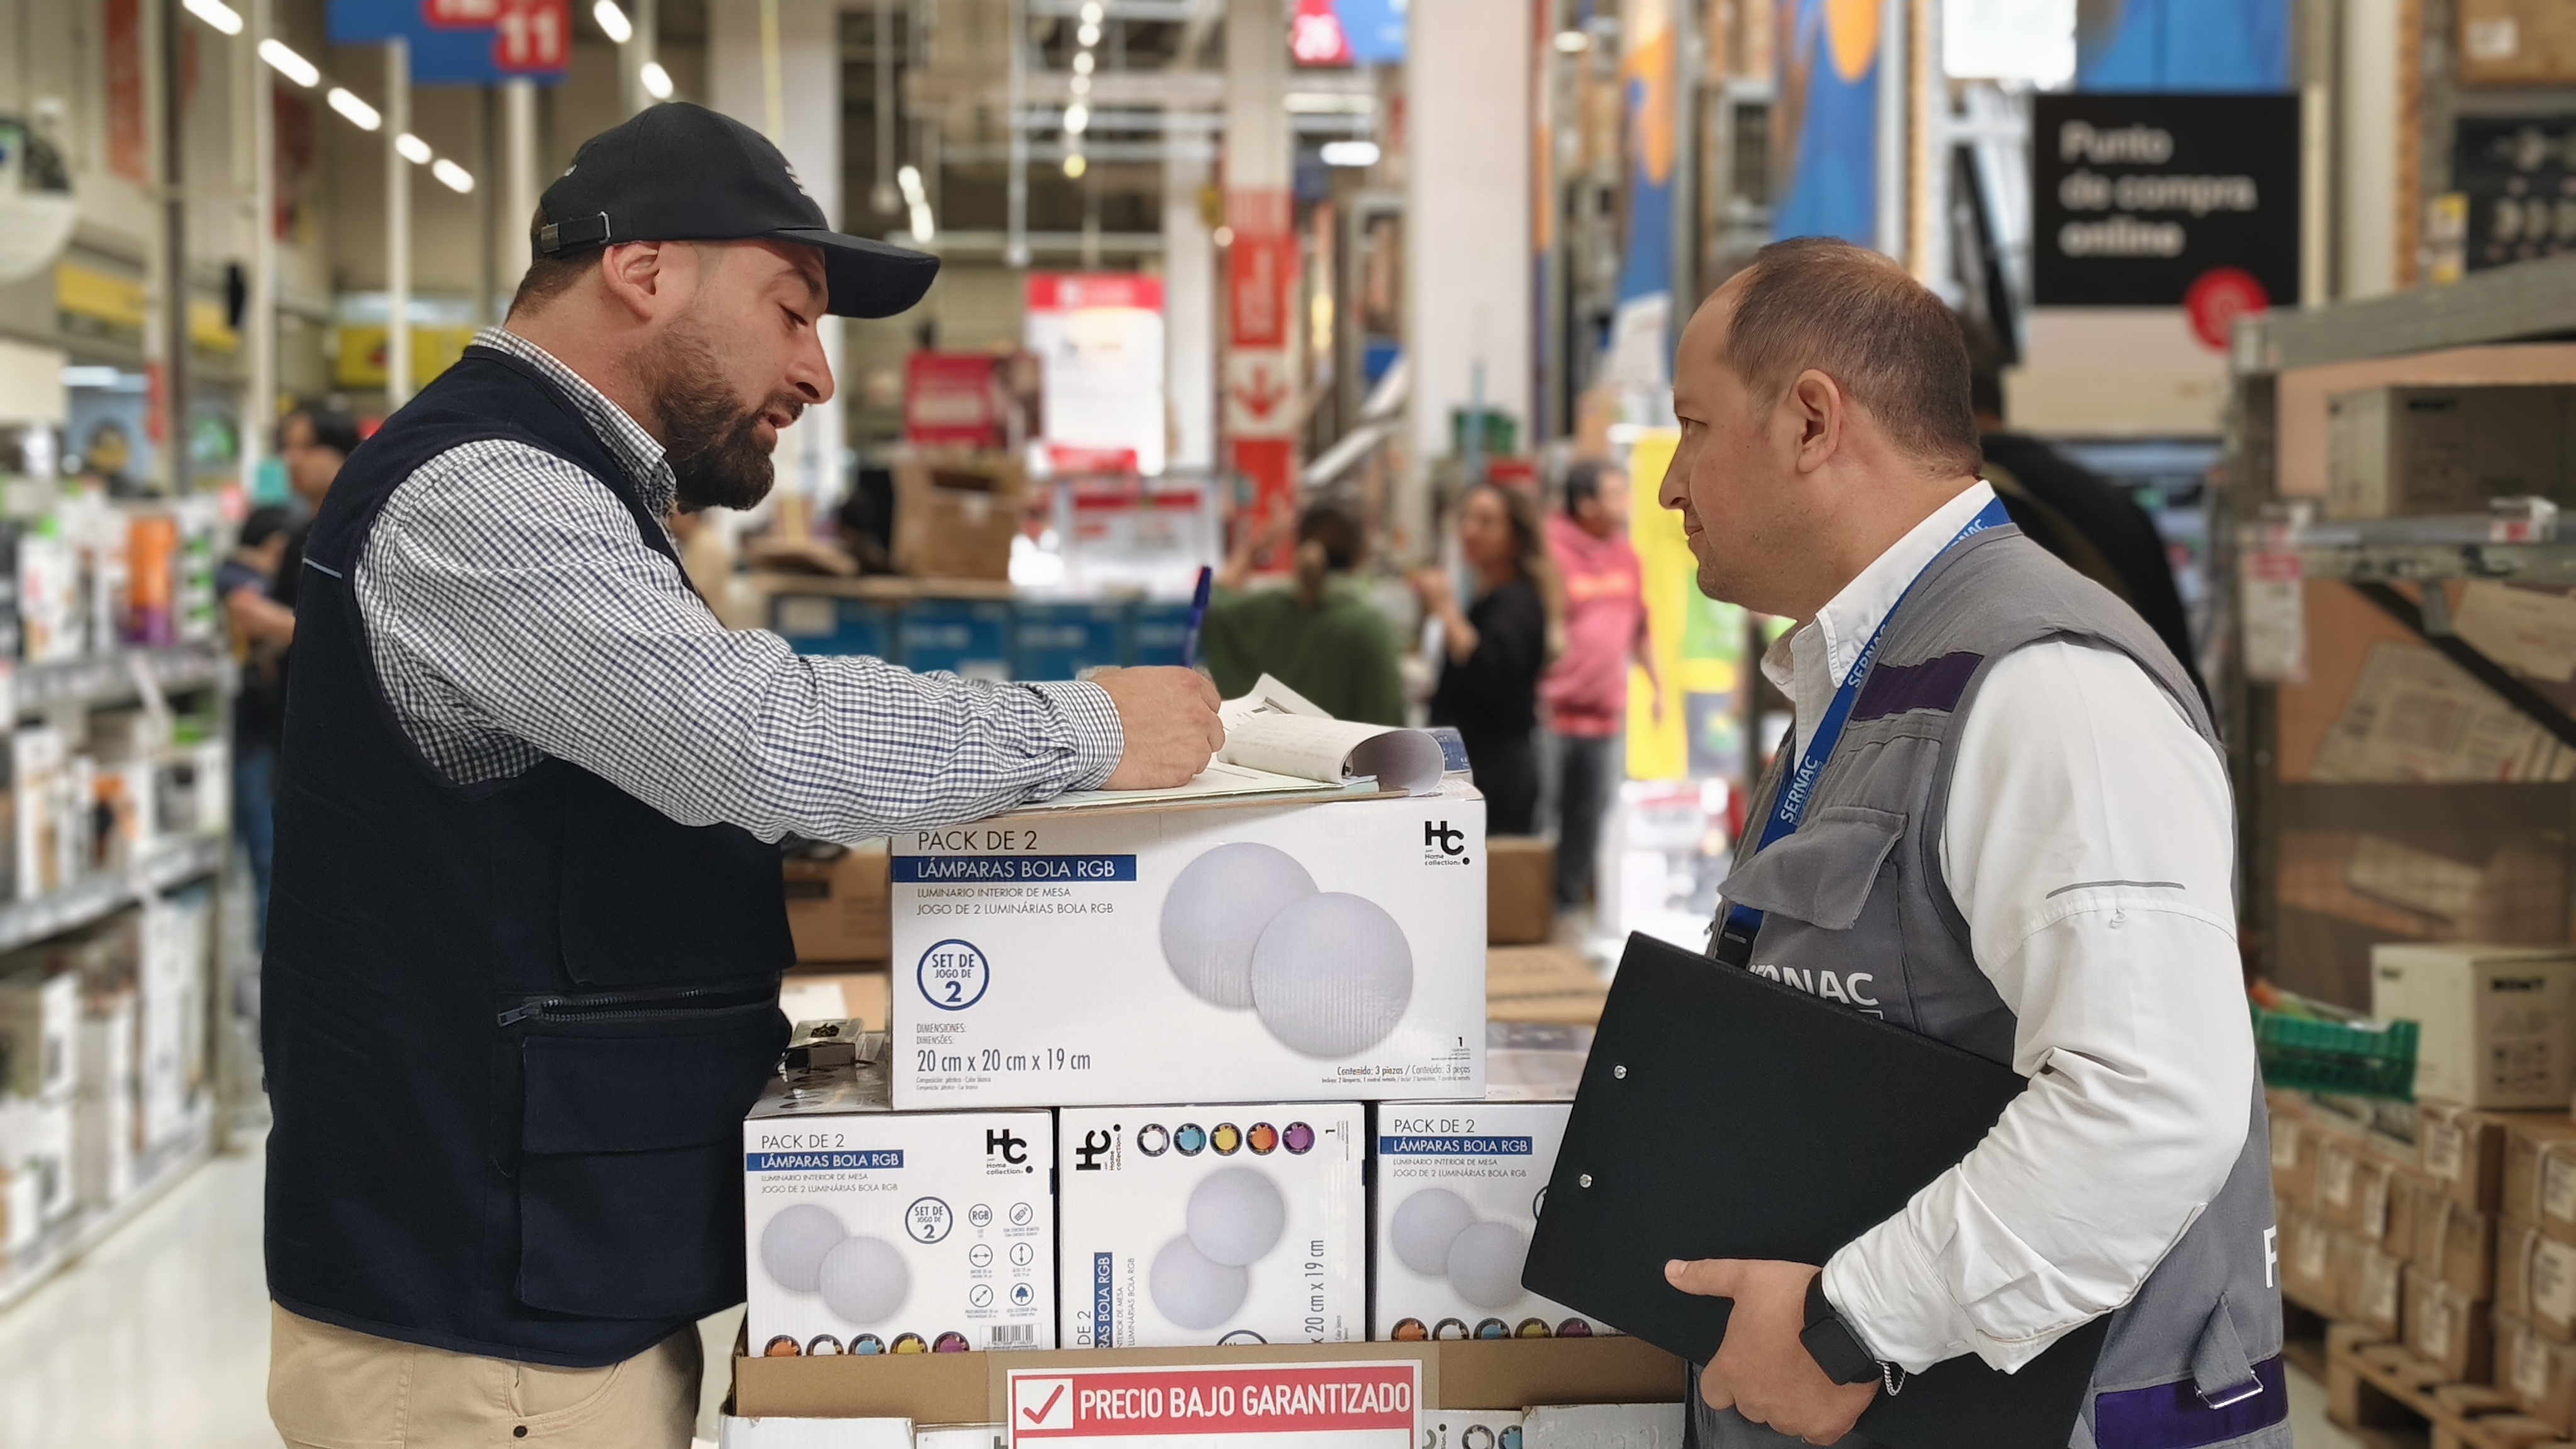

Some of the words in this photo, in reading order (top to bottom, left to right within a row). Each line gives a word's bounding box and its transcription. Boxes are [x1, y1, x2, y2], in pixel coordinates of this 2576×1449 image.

[2060, 121, 2174, 164] Punto
[2059, 169, 2112, 211] de
[2115, 175, 2257, 218] compra
[2059, 216, 2185, 257] online
[1780, 755, 1818, 823] SERNAC
[918, 831, 978, 851] PACK
[987, 831, 1015, 850] DE
[1024, 830, 1037, 850] 2
[917, 858, 1014, 879] LÁMPARAS
[1021, 860, 1071, 877] BOLA
[1077, 860, 1115, 877] RGB
[917, 888, 974, 898] LUMINARIO
[978, 887, 1023, 897] INTERIOR
[1026, 887, 1040, 897] DE
[1042, 887, 1071, 897] MESA
[916, 904, 952, 916] JOGO
[955, 904, 970, 914] DE
[974, 904, 981, 914] 2
[985, 901, 1054, 914] LUMINÁRIAS
[1057, 904, 1086, 914] BOLA
[1091, 904, 1114, 914] RGB
[932, 953, 954, 969] SET
[959, 953, 975, 968] DE
[935, 969, 958, 979] JOGO
[962, 969, 972, 978] DE
[945, 980, 962, 1002] 2
[1458, 1036, 1463, 1047] 1
[917, 1049, 936, 1072] 20
[941, 1054, 962, 1071] cm
[967, 1055, 976, 1071] x
[982, 1049, 1001, 1071] 20
[1006, 1053, 1026, 1070] cm
[1031, 1054, 1040, 1070] x
[1048, 1048, 1065, 1070] 19
[1071, 1053, 1091, 1069] cm
[1394, 1119, 1434, 1133] PACK
[1441, 1119, 1459, 1133] DE
[1466, 1119, 1475, 1133] 2
[762, 1135, 803, 1148] PACK
[809, 1135, 828, 1148] DE
[835, 1134, 844, 1148] 2
[1394, 1137, 1460, 1152] LÁMPARAS
[1463, 1140, 1497, 1152] BOLA
[1502, 1140, 1528, 1152] RGB
[761, 1153, 829, 1169] LÁMPARAS
[833, 1155, 868, 1167] BOLA
[872, 1153, 899, 1166] RGB
[915, 1206, 929, 1216] SET
[933, 1206, 943, 1216] DE
[973, 1211, 989, 1220] RGB
[924, 1224, 935, 1239] 2
[1311, 1240, 1324, 1257] cm
[1098, 1257, 1110, 1284] RGB
[1305, 1262, 1324, 1277] 19
[1098, 1287, 1110, 1321] BOLA
[1311, 1295, 1324, 1312] cm
[1077, 1311, 1091, 1319] 2
[1305, 1317, 1324, 1333] 20
[1077, 1326, 1091, 1345] DE
[1080, 1388, 1163, 1420] PRECIO
[1170, 1386, 1235, 1419] BAJO
[1242, 1382, 1411, 1416] GARANTIZADO
